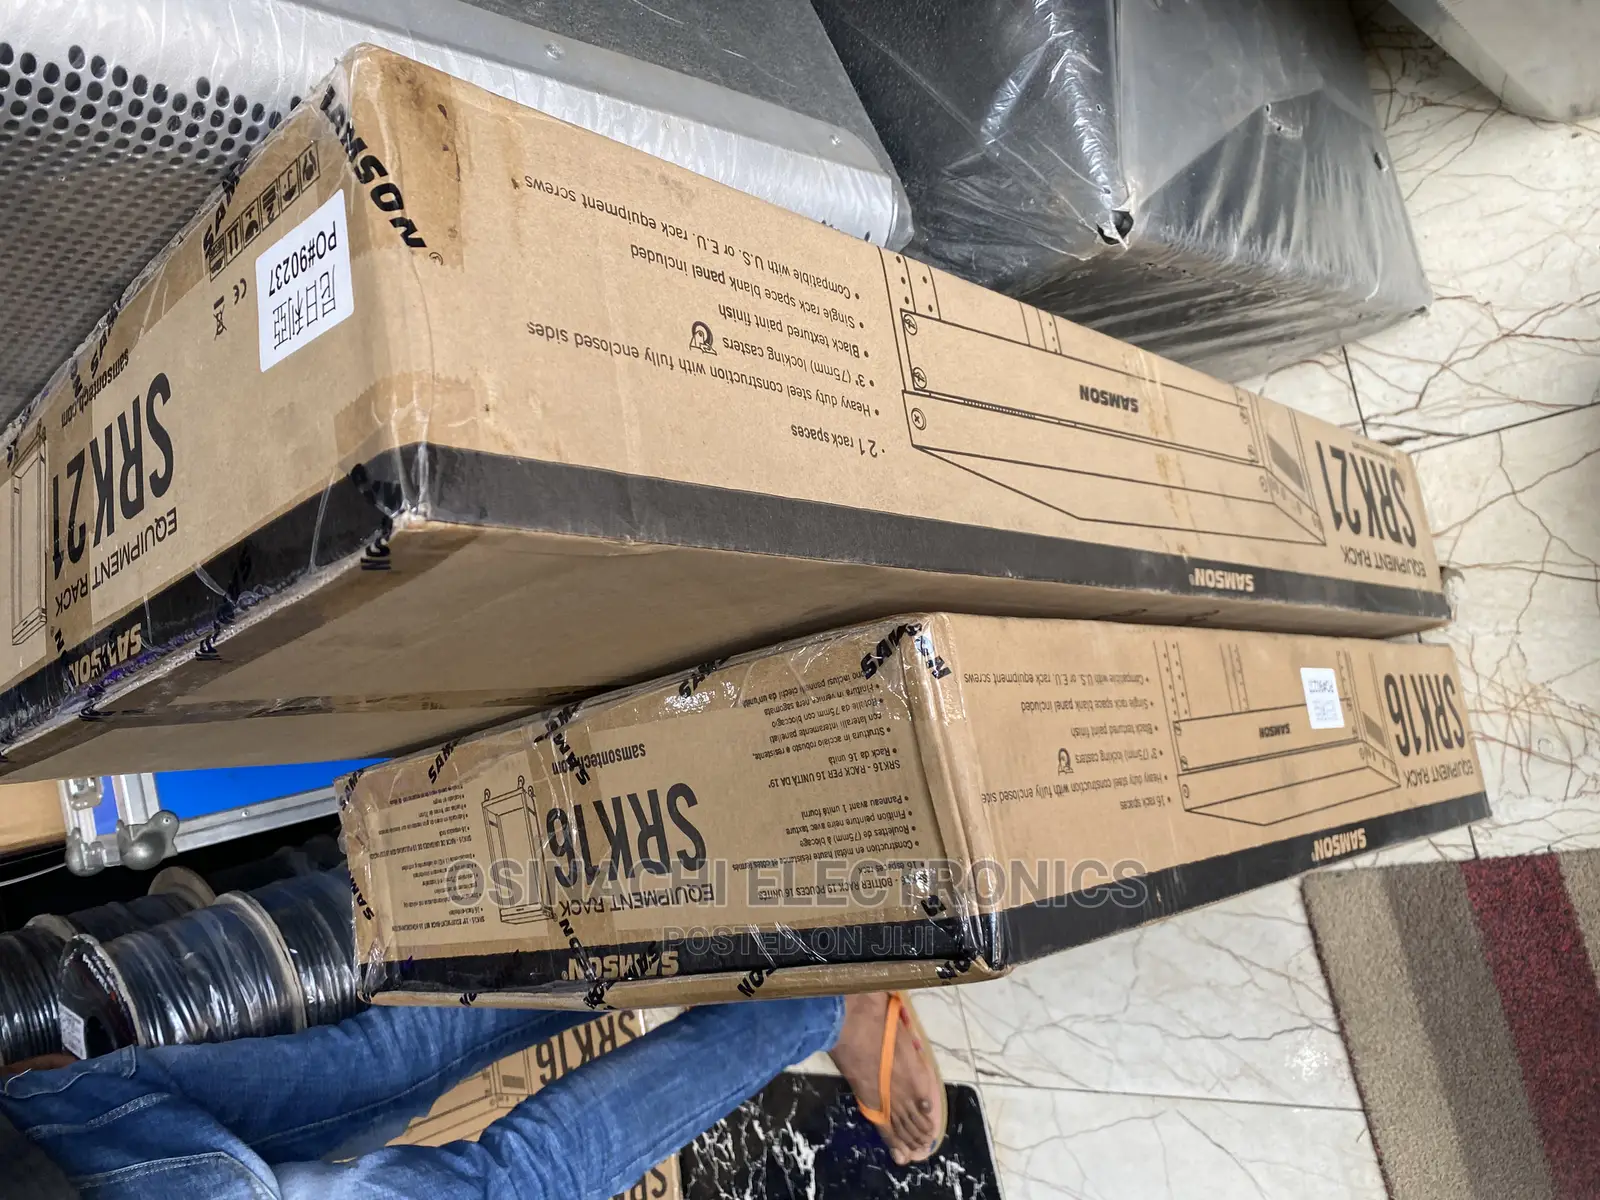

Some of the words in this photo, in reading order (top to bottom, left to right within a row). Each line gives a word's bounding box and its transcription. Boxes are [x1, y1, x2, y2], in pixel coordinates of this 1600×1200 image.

[524, 175, 576, 202] screws
[581, 194, 656, 230] equipment
[660, 222, 688, 241] rack
[692, 233, 719, 255] E.U.
[724, 244, 734, 257] or
[269, 220, 337, 296] PO#90237
[630, 244, 687, 276] included
[739, 249, 764, 270] U.S.
[691, 263, 726, 287] panel
[767, 260, 790, 277] with
[729, 277, 761, 299] blank
[793, 270, 851, 299] Compatible
[765, 289, 796, 307] space
[272, 264, 336, 350] 尼日利亞
[799, 300, 820, 315] rack
[718, 304, 752, 325] finish
[823, 308, 855, 328] Single
[755, 315, 783, 332] paint
[526, 322, 568, 344] sides
[787, 325, 829, 347] textured
[574, 333, 639, 358] enclosed
[722, 337, 764, 358] casters
[832, 338, 860, 358] Black
[644, 347, 674, 370] fully
[766, 346, 807, 371] locking
[679, 358, 706, 375] with
[810, 360, 851, 383] (75mm)
[710, 366, 783, 393] construction
[61, 347, 129, 429] samsontech.com
[787, 385, 811, 401] steel
[815, 389, 837, 408] duty
[1079, 384, 1139, 413] SAMSON
[841, 396, 871, 417] Heavy
[791, 424, 829, 444] spaces
[831, 433, 854, 448] rack
[52, 372, 174, 581] SRK21
[1315, 440, 1417, 549] SRK21
[92, 506, 177, 591] EQUIPMENT
[1340, 545, 1372, 568] RACK
[1372, 551, 1427, 577] EQUIPMENT
[1193, 568, 1255, 592] SAMSON
[54, 570, 88, 617] RACK
[964, 673, 990, 684] screws
[993, 671, 1034, 686] equipment
[1035, 674, 1051, 686] rack
[1052, 674, 1068, 684] E.U.
[1070, 675, 1076, 683] or
[1079, 674, 1093, 684] U.S.
[1094, 674, 1108, 685] with
[1109, 671, 1143, 685] Compatible
[1021, 701, 1053, 713] included
[1054, 698, 1074, 712] panel
[1074, 700, 1094, 711] blank
[1094, 697, 1113, 710] space
[1114, 699, 1128, 710] rack
[1128, 697, 1148, 710] Single
[803, 712, 815, 721] con
[817, 706, 840, 716] 75mm
[1384, 673, 1465, 757] SRK16
[798, 723, 838, 736] interamente
[852, 727, 885, 739] Struttura
[1071, 726, 1090, 739] finish
[1090, 723, 1107, 738] paint
[1109, 724, 1134, 737] textured
[1135, 723, 1153, 735] Black
[1259, 723, 1291, 739] SAMSON
[792, 741, 816, 751] robusto
[818, 736, 841, 746] acciaio
[848, 753, 857, 761] 16
[860, 751, 869, 759] da
[872, 747, 890, 757] Rack
[1099, 750, 1122, 763] locking
[1124, 748, 1149, 761] (75mm)
[828, 755, 846, 765] unità
[873, 759, 900, 772] SRK16
[1075, 754, 1098, 765] casters
[816, 772, 826, 780] 16
[828, 769, 842, 778] PER
[845, 764, 866, 777] RACK
[1431, 758, 1473, 784] EQUIPMENT
[780, 777, 791, 786] DA
[792, 773, 814, 786] UNITÀ
[1113, 778, 1128, 789] steel
[1129, 774, 1142, 786] duty
[1144, 772, 1163, 784] Heavy
[1403, 768, 1429, 788] RACK
[1035, 784, 1052, 799] fully
[1053, 784, 1070, 797] with
[1071, 779, 1111, 793] construction
[870, 794, 902, 806] Panneau
[999, 788, 1033, 804] enclosed
[1142, 797, 1155, 808] rack
[842, 804, 846, 813] 1
[849, 800, 867, 811] avant
[1120, 797, 1141, 810] spaces
[845, 813, 875, 825] peinture
[877, 809, 905, 820] Finition
[810, 821, 825, 830] avec
[874, 824, 909, 835] Roulettes
[545, 782, 707, 889] SRK16
[834, 831, 861, 843] (75mm)
[863, 830, 872, 838] de
[800, 836, 825, 847] blocage
[866, 840, 913, 853] Construction
[1314, 828, 1366, 861] SAMSON
[813, 850, 832, 860] haute
[855, 846, 864, 855] en
[785, 888, 794, 897] 16
[796, 885, 825, 895] POUCES
[826, 883, 836, 892] 19
[838, 881, 859, 892] RACK
[611, 883, 714, 912] EQUIPMENT
[558, 896, 604, 918] RACK
[567, 950, 679, 978] SAMSON
[536, 1010, 638, 1085] SRK16
